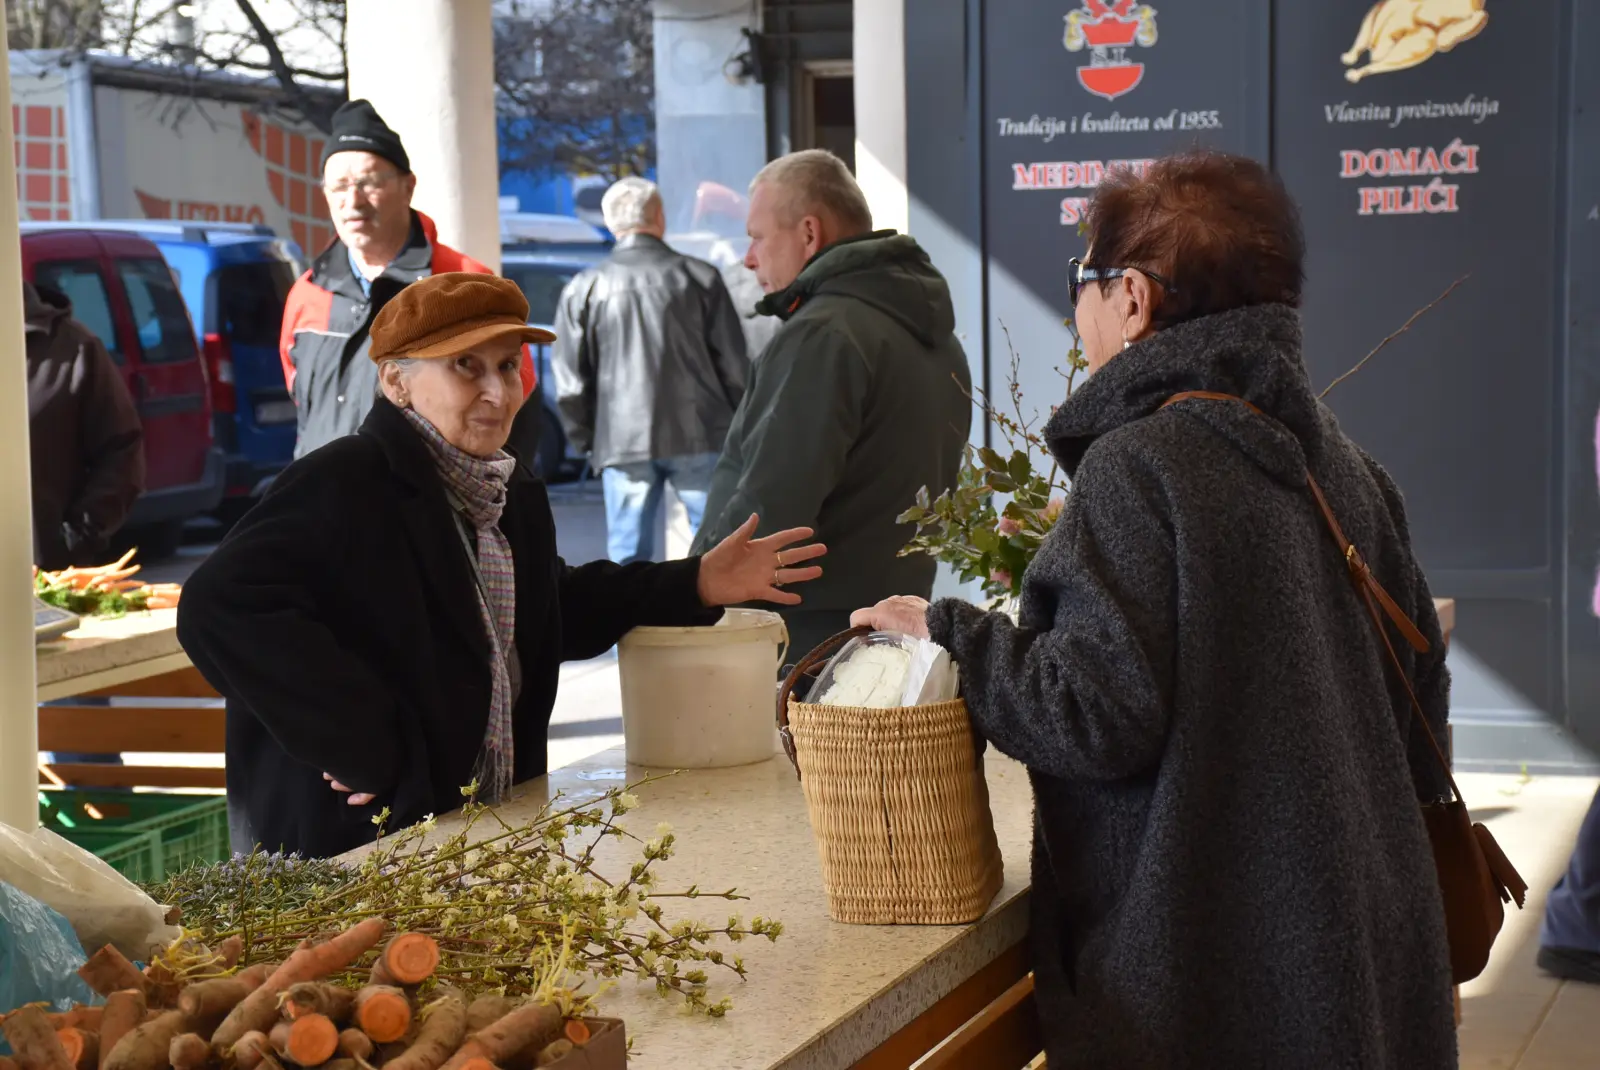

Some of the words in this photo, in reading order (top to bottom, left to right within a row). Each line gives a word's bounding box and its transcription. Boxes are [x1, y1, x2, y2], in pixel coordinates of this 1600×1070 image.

[997, 114, 1066, 142] Tradicija
[1070, 116, 1077, 133] i
[1081, 111, 1150, 133] kvaliteta
[1153, 109, 1178, 131] od
[1324, 101, 1392, 123] Vlastita
[1388, 94, 1500, 128] proizvodnja
[1339, 136, 1480, 178] DOMAĆI
[1357, 176, 1460, 215] PILIĆI
